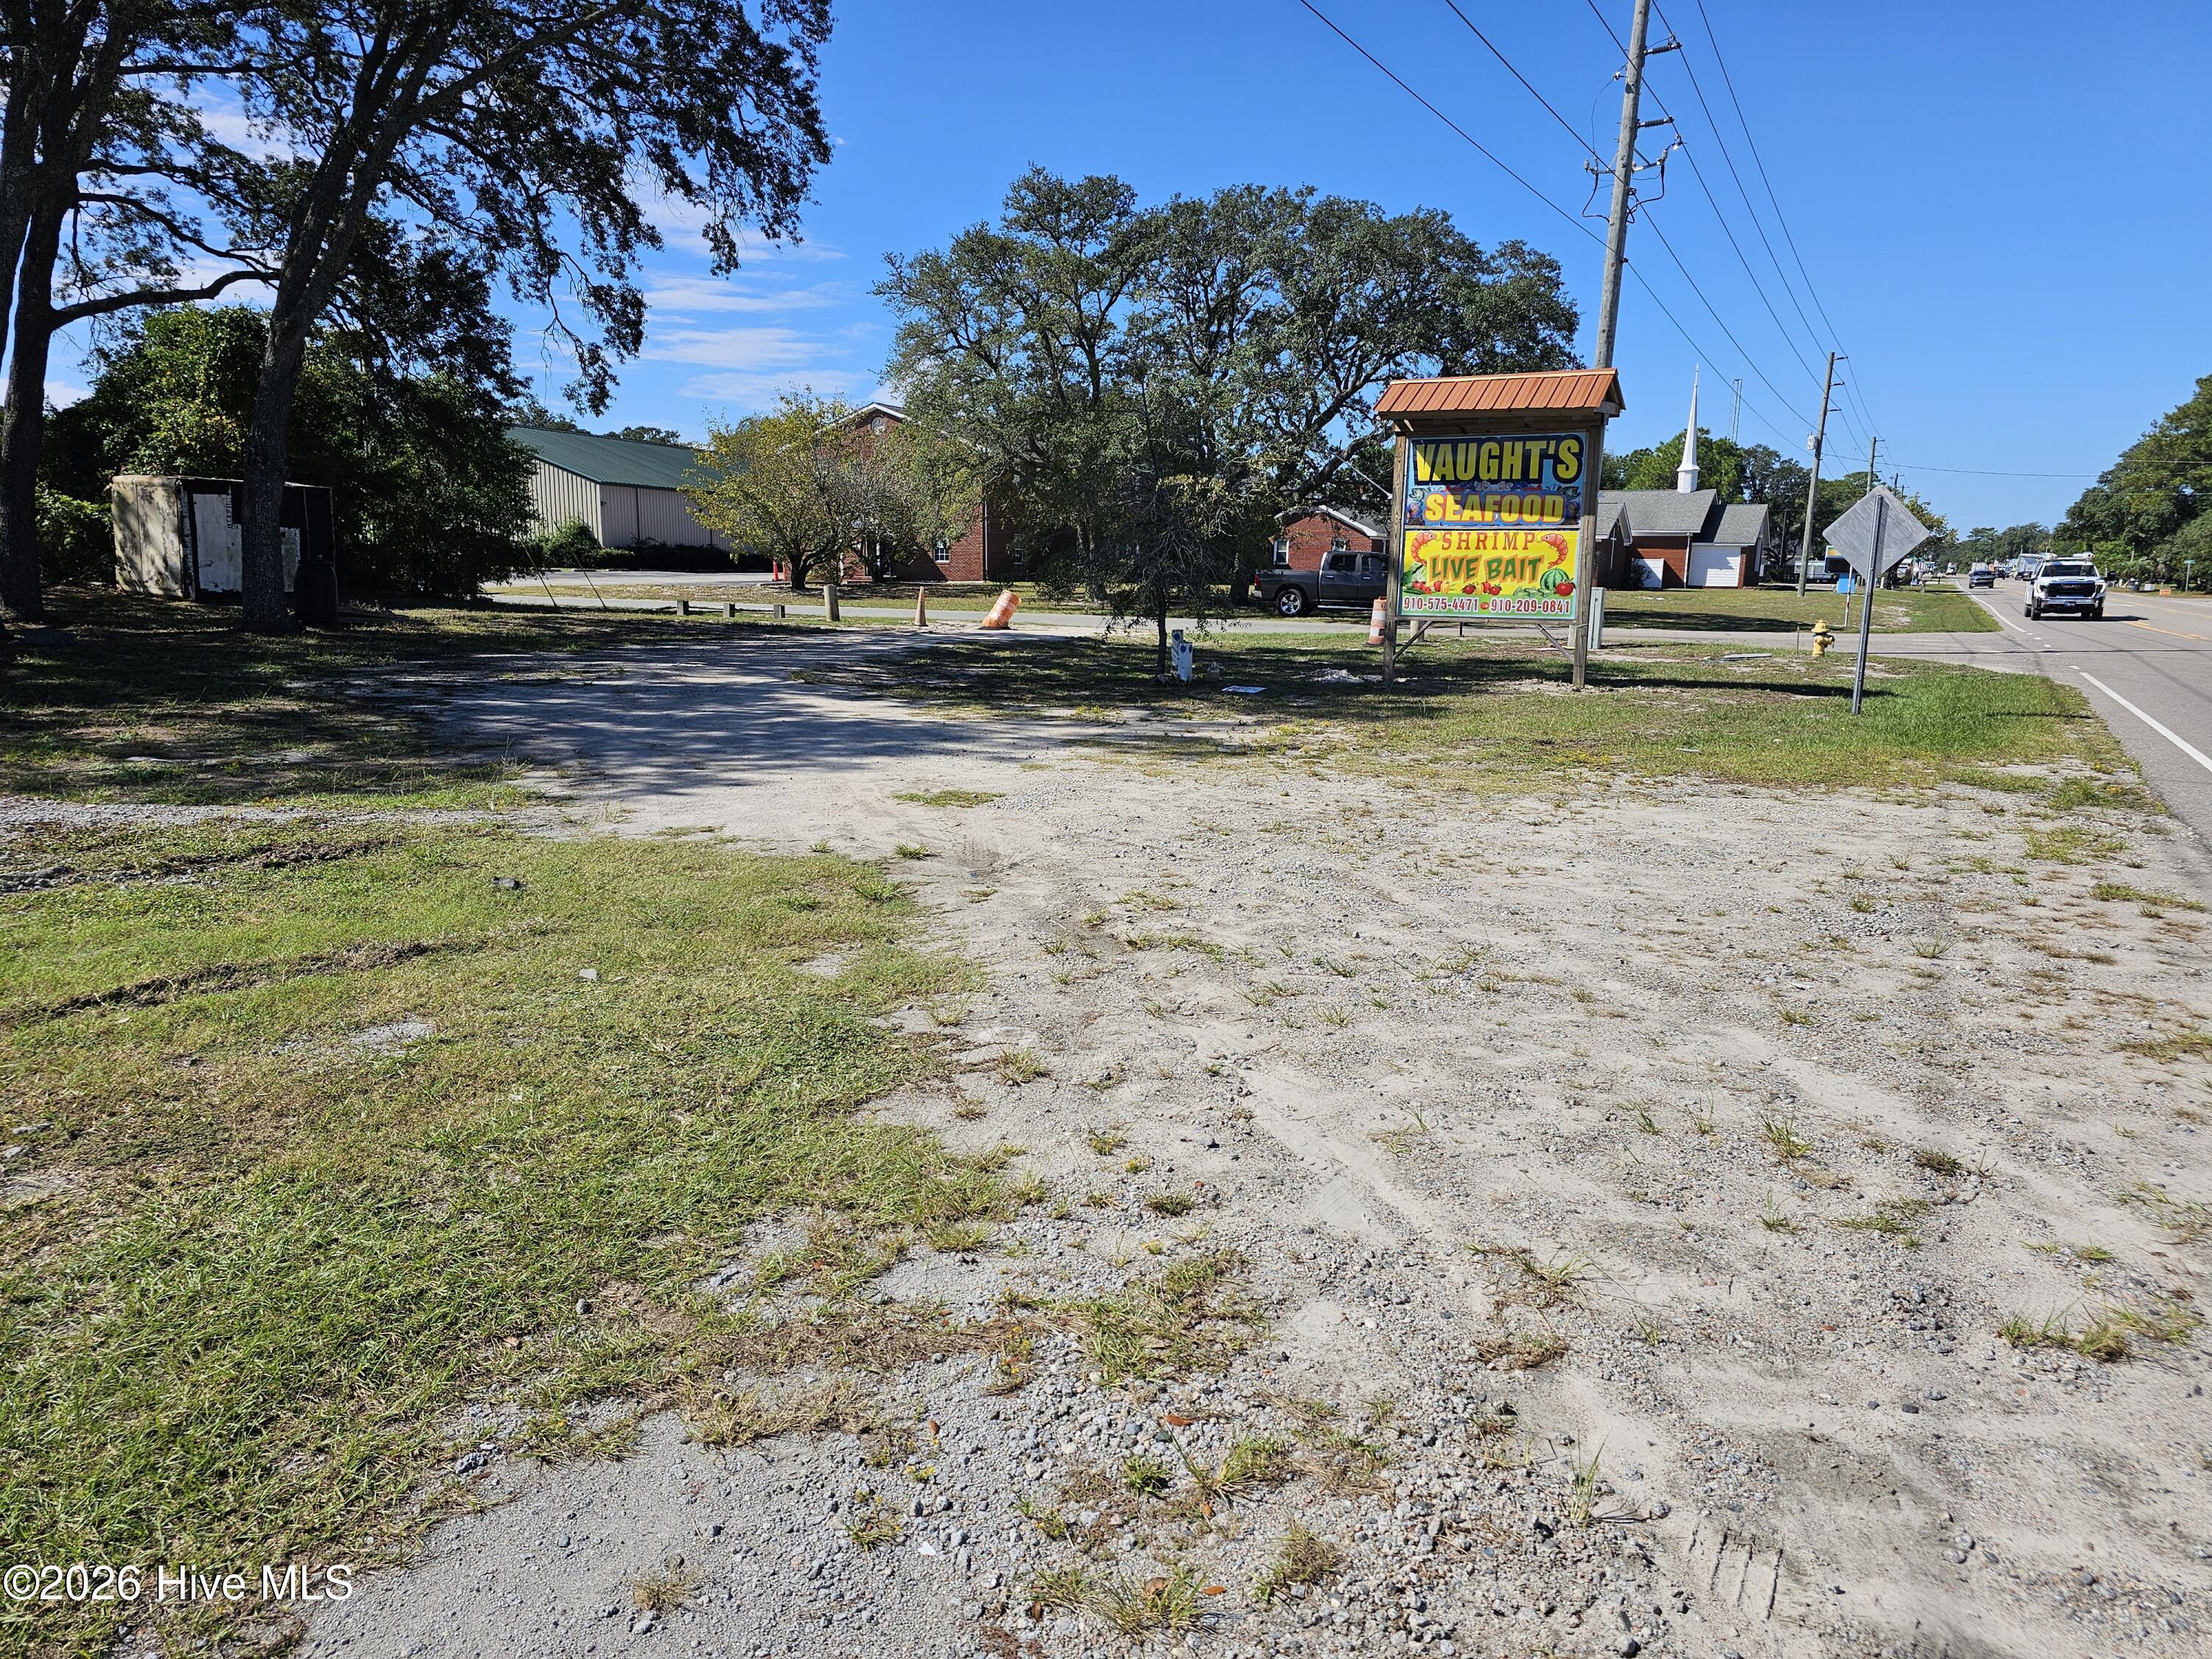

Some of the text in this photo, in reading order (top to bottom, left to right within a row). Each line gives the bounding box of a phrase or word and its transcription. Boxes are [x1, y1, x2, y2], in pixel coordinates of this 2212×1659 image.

[1416, 439, 1579, 481] VAUGHT'S
[1425, 493, 1565, 523] SEAFOOD
[1441, 532, 1535, 551] SHRIMP
[1430, 555, 1543, 582] LIVE BAIT
[1403, 597, 1570, 613] 910-575-4471 910-209-0841
